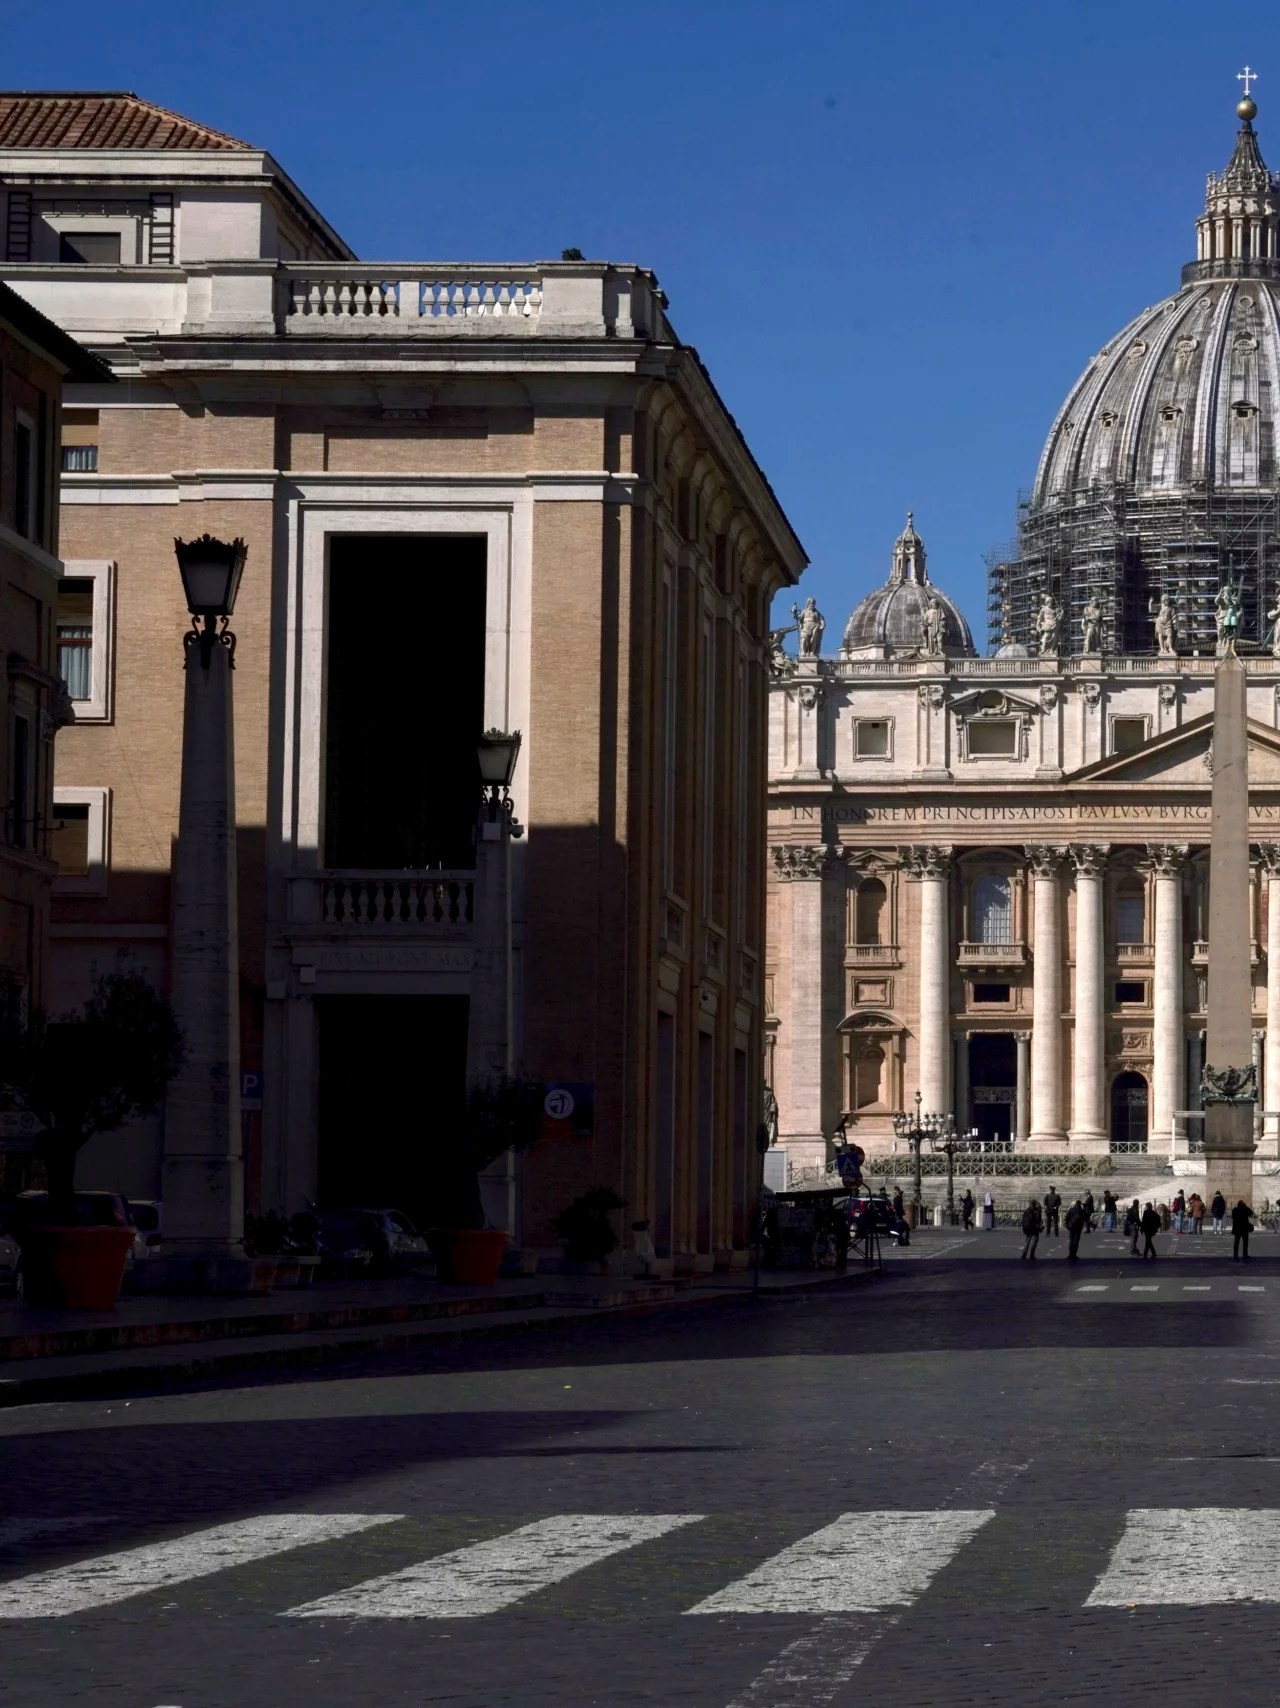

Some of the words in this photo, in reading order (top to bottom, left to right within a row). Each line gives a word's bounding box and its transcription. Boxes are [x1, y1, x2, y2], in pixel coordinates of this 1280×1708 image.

[793, 805, 814, 820] IN
[823, 806, 918, 821] HONOREM
[923, 805, 1016, 821] PRINCIPIS
[1020, 805, 1075, 820] APOST
[1078, 805, 1140, 819] PAVLVS
[243, 1074, 259, 1095] P
